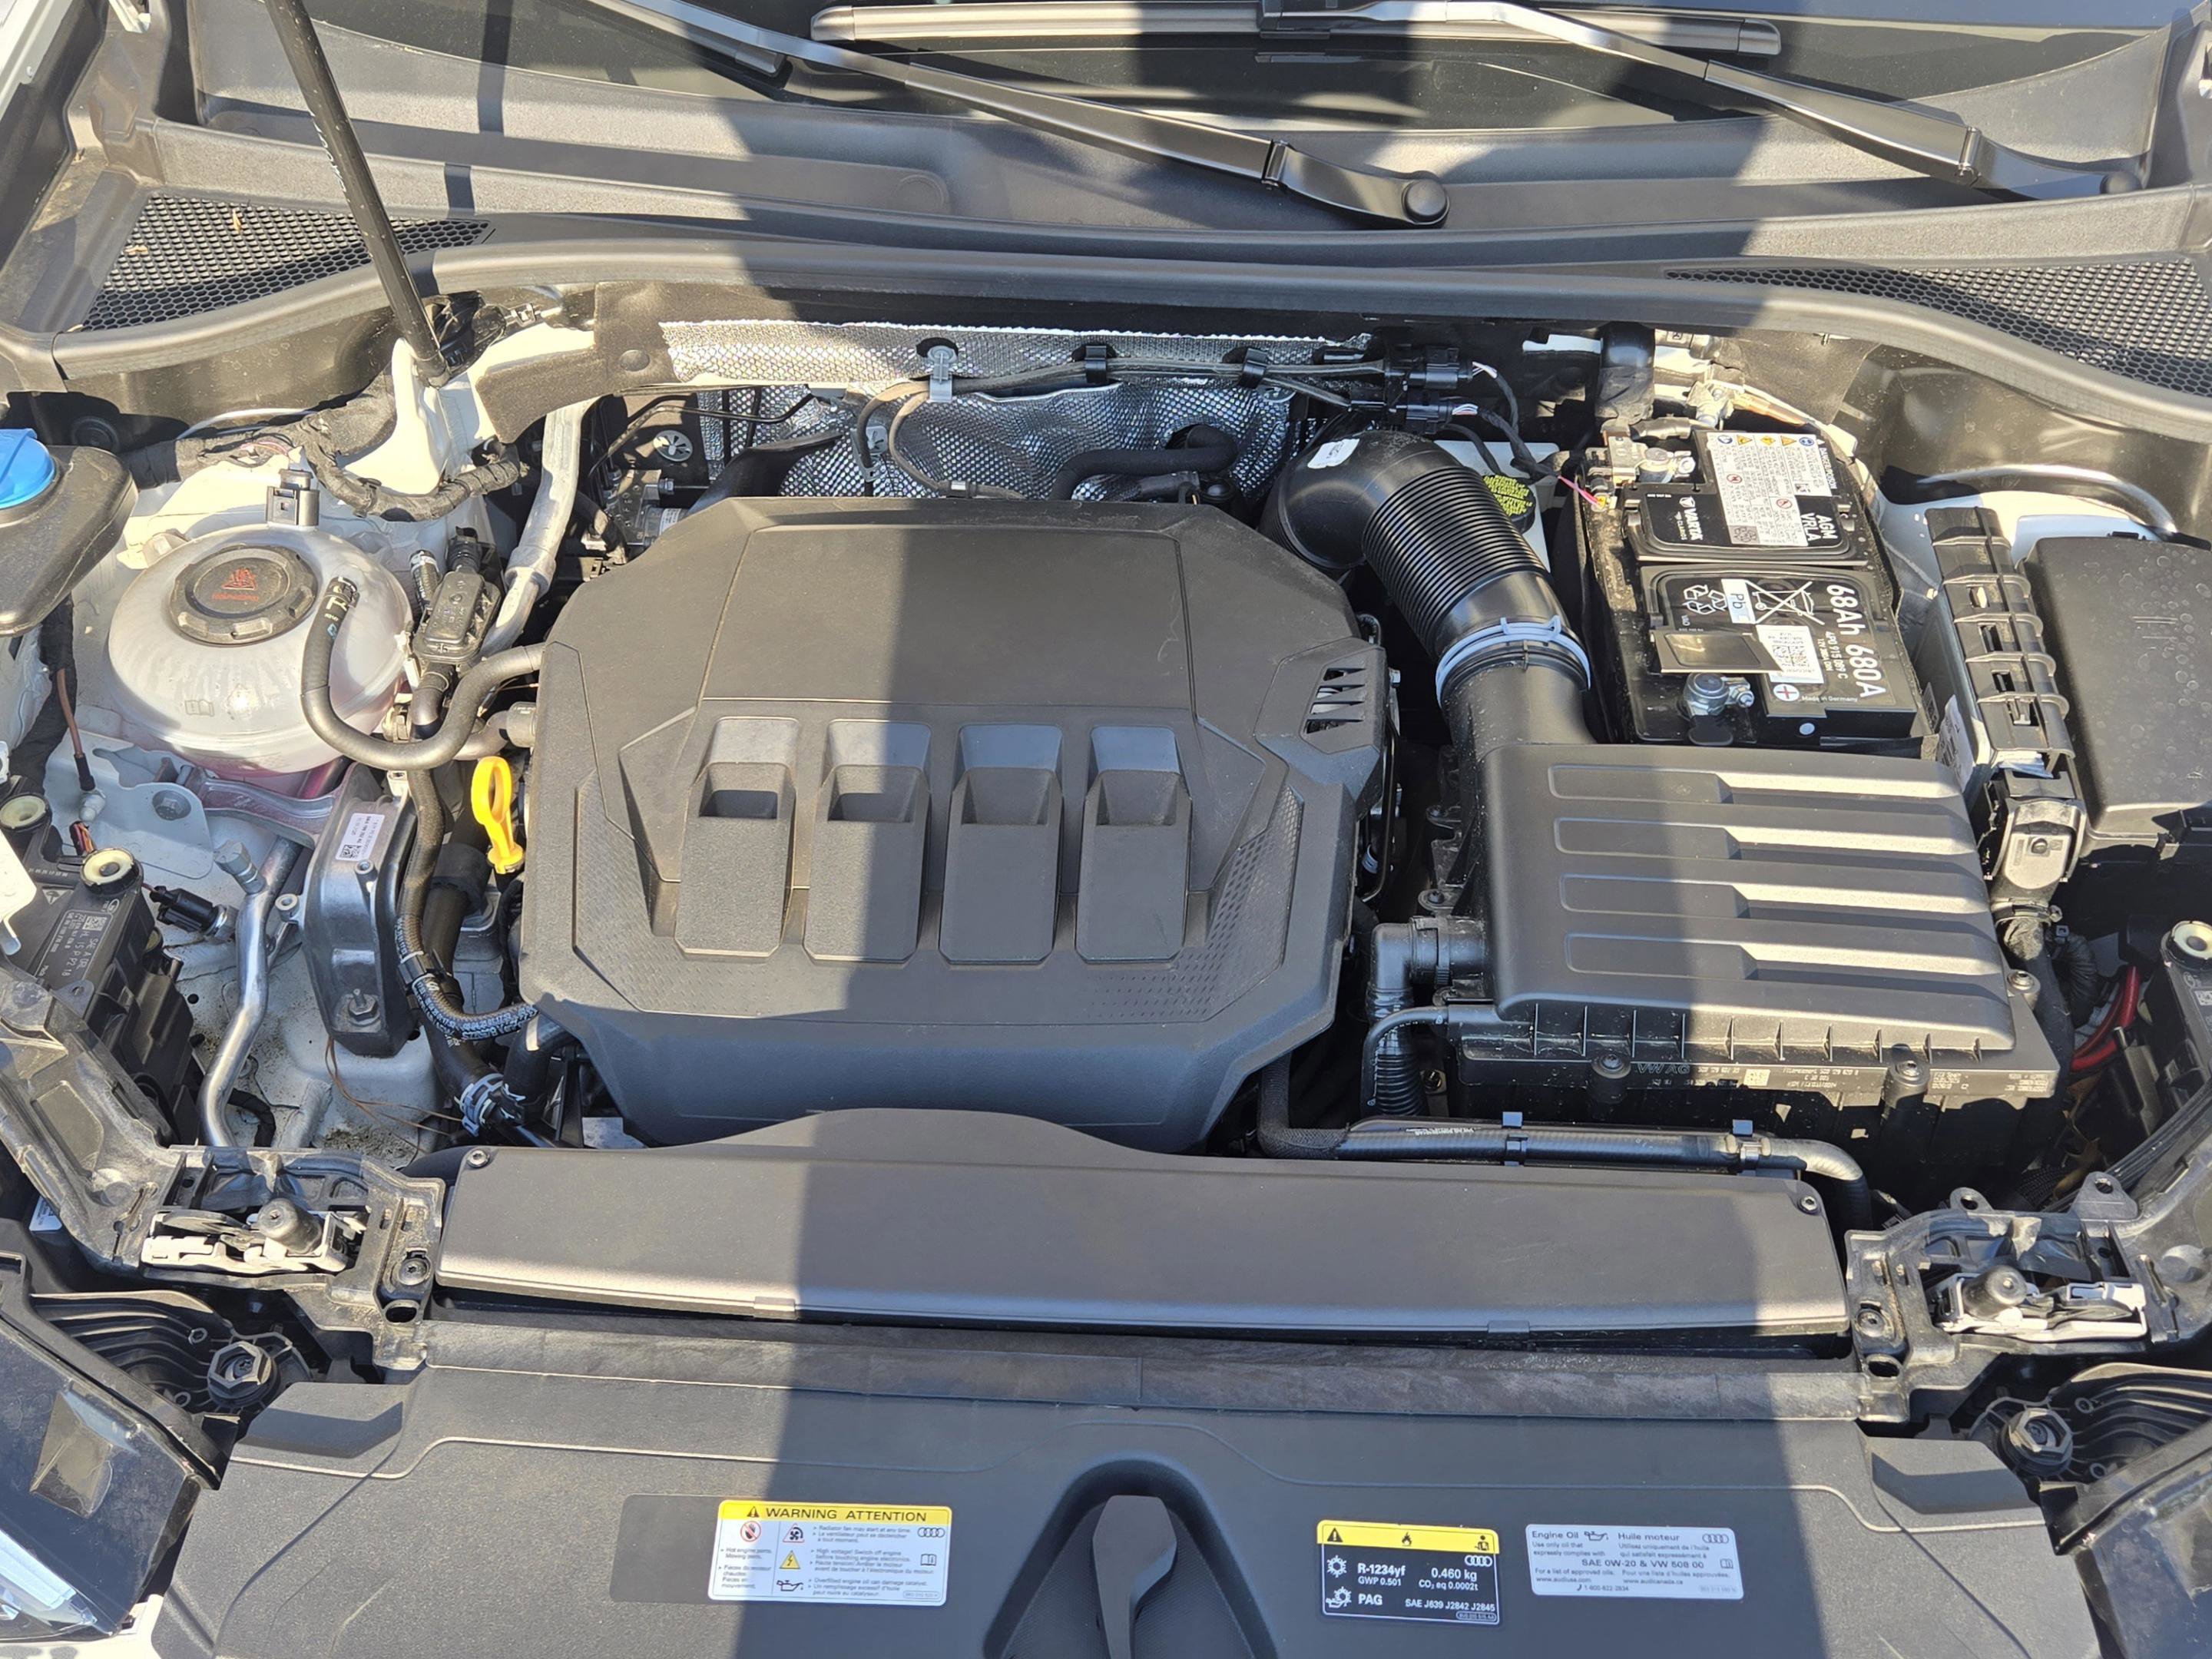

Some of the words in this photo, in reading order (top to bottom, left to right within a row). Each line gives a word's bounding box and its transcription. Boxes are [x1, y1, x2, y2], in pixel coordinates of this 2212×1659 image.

[1684, 508, 1703, 540] VARTA
[1800, 512, 1821, 541] VRLA
[1816, 515, 1838, 539] AGM
[1730, 594, 1746, 608] Pb
[1826, 584, 1866, 635] 68Ah
[1829, 646, 1842, 658] 915
[1845, 644, 1886, 697] 680A
[85, 938, 98, 950] SAE
[1637, 1063, 1665, 1074] VW
[1665, 1063, 1690, 1074] AG
[766, 1508, 837, 1519] WARNING
[846, 1510, 926, 1522] ATTENTION
[1532, 1531, 1563, 1539] Engine
[1357, 1562, 1406, 1577] R-1234yf
[1432, 1568, 1461, 1579] 0.460
[1464, 1569, 1477, 1581] kg
[1358, 1576, 1379, 1585] GWP
[1380, 1578, 1401, 1586] 0.501
[1436, 1582, 1446, 1591] eq
[1448, 1581, 1478, 1591] 0.0002t
[1359, 1594, 1382, 1606] PAG
[1405, 1599, 1422, 1608] SAE
[1424, 1600, 1444, 1609] J639
[1445, 1602, 1469, 1611] J2842
[1471, 1603, 1495, 1612] J2845
